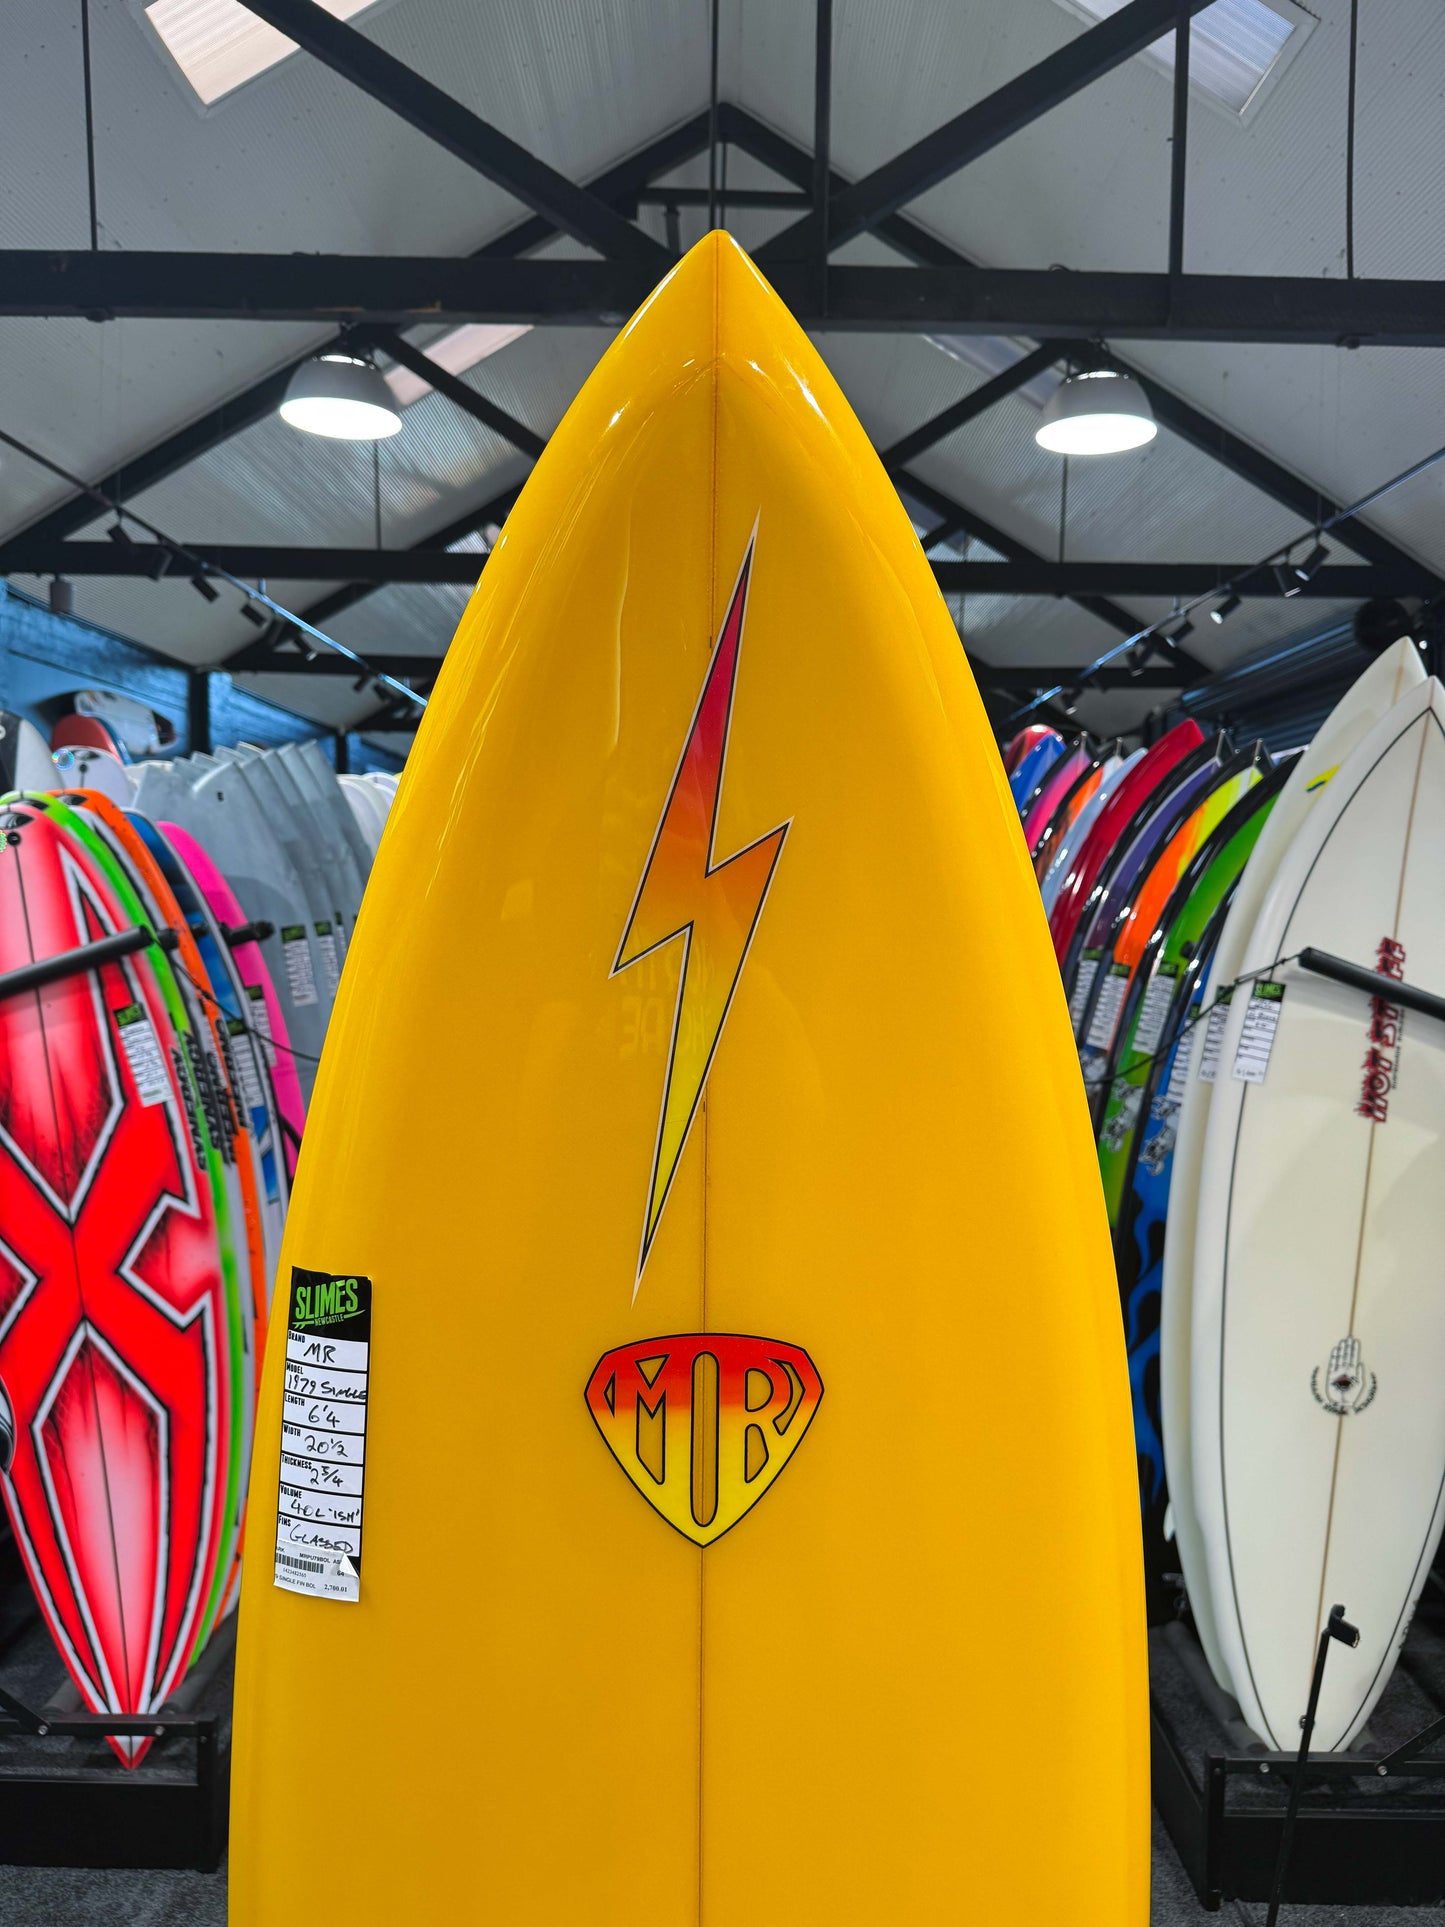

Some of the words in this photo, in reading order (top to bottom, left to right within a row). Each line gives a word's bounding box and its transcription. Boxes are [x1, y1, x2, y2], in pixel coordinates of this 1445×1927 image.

[1366, 936, 1406, 1048] STFF
[1354, 1047, 1393, 1123] HOT
[295, 1278, 358, 1320] SLIMES
[314, 1313, 344, 1326] NEWCASTLE
[303, 1342, 337, 1364] MR
[288, 1374, 317, 1395] 1979
[284, 1392, 306, 1407] LENGTH
[308, 1404, 341, 1428] 6'4
[584, 1333, 825, 1549] MR
[281, 1453, 312, 1470] THICKNESS
[280, 1485, 303, 1499] VOLUME
[289, 1523, 354, 1554] GLASSED
